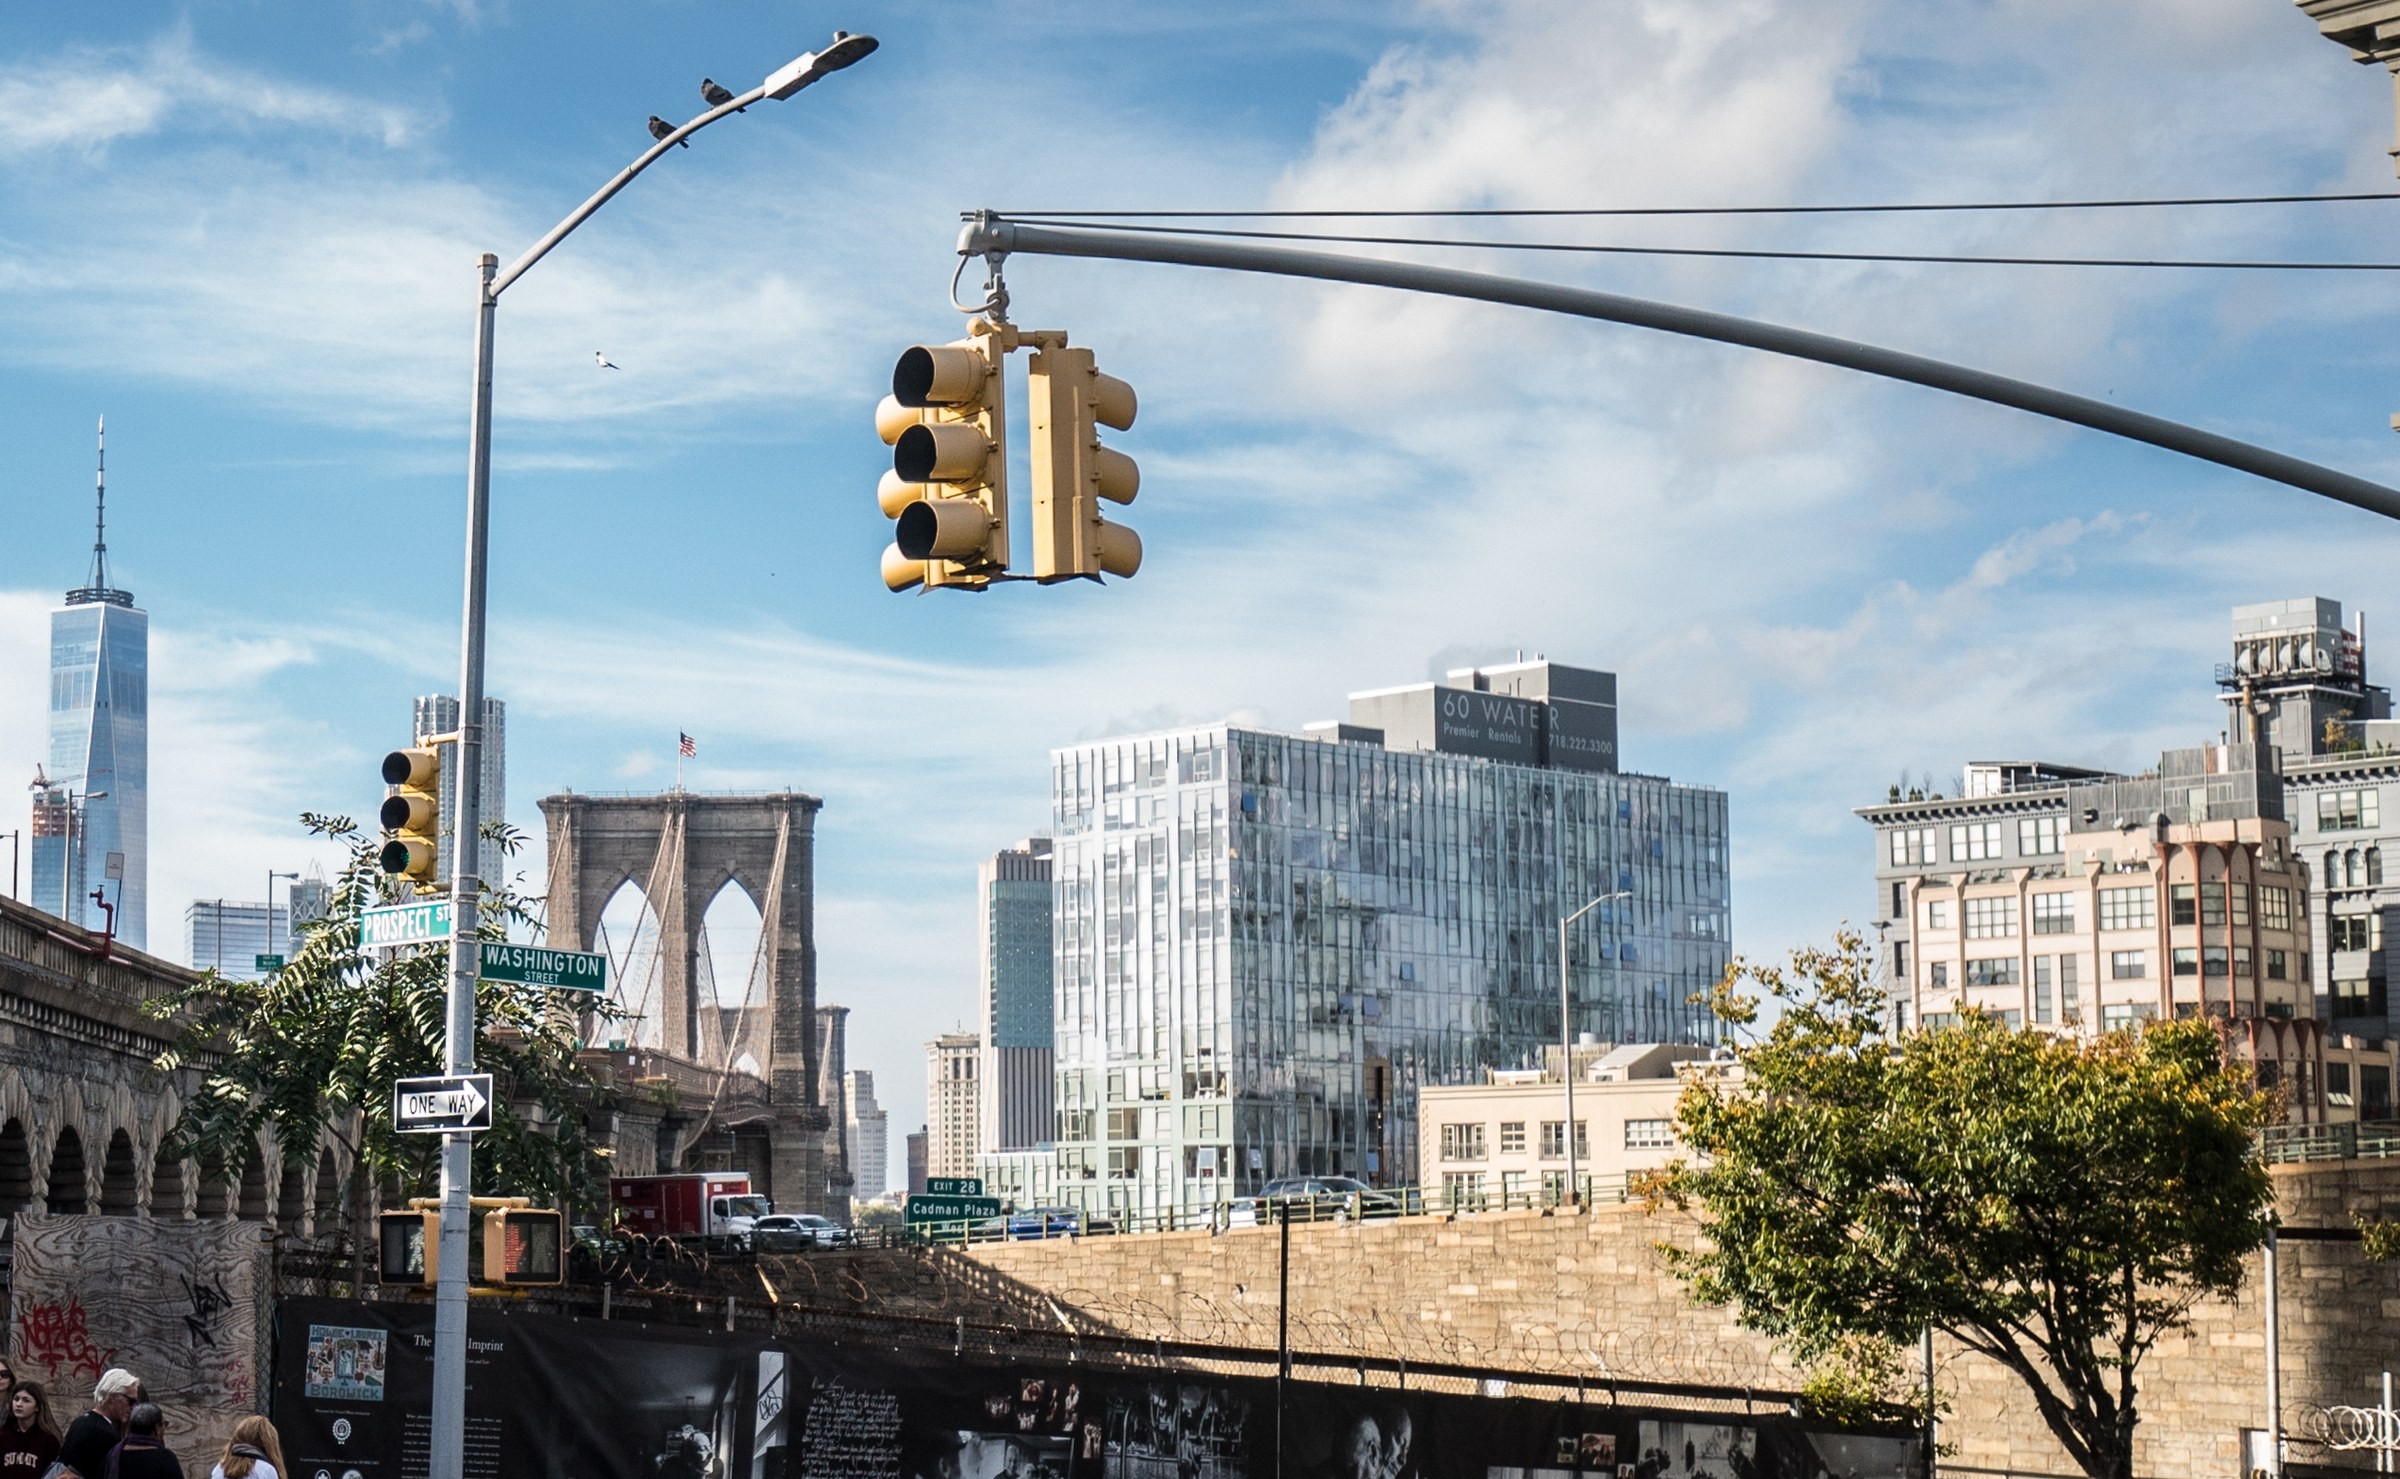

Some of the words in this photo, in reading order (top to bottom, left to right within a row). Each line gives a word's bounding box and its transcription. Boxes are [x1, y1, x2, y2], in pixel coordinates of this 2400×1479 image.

[1443, 693, 1469, 719] 60
[1443, 721, 1479, 739] Premier
[1488, 727, 1521, 745] Rentals
[1549, 733, 1613, 754] 718.222.3300
[363, 906, 432, 943] PROSPECT
[436, 905, 449, 922] ST
[486, 945, 599, 977] WASHINGTON
[524, 970, 559, 984] STREET
[409, 1095, 436, 1115] ONE
[448, 1093, 476, 1114] WAY
[934, 1181, 953, 1191] EXIT
[960, 1180, 976, 1194] 28
[913, 1203, 959, 1215] Cadman
[964, 1204, 996, 1216] Plaza
[413, 1334, 432, 1347] The
[467, 1338, 504, 1353] Imprint
[310, 1385, 379, 1399] BOROWICK
